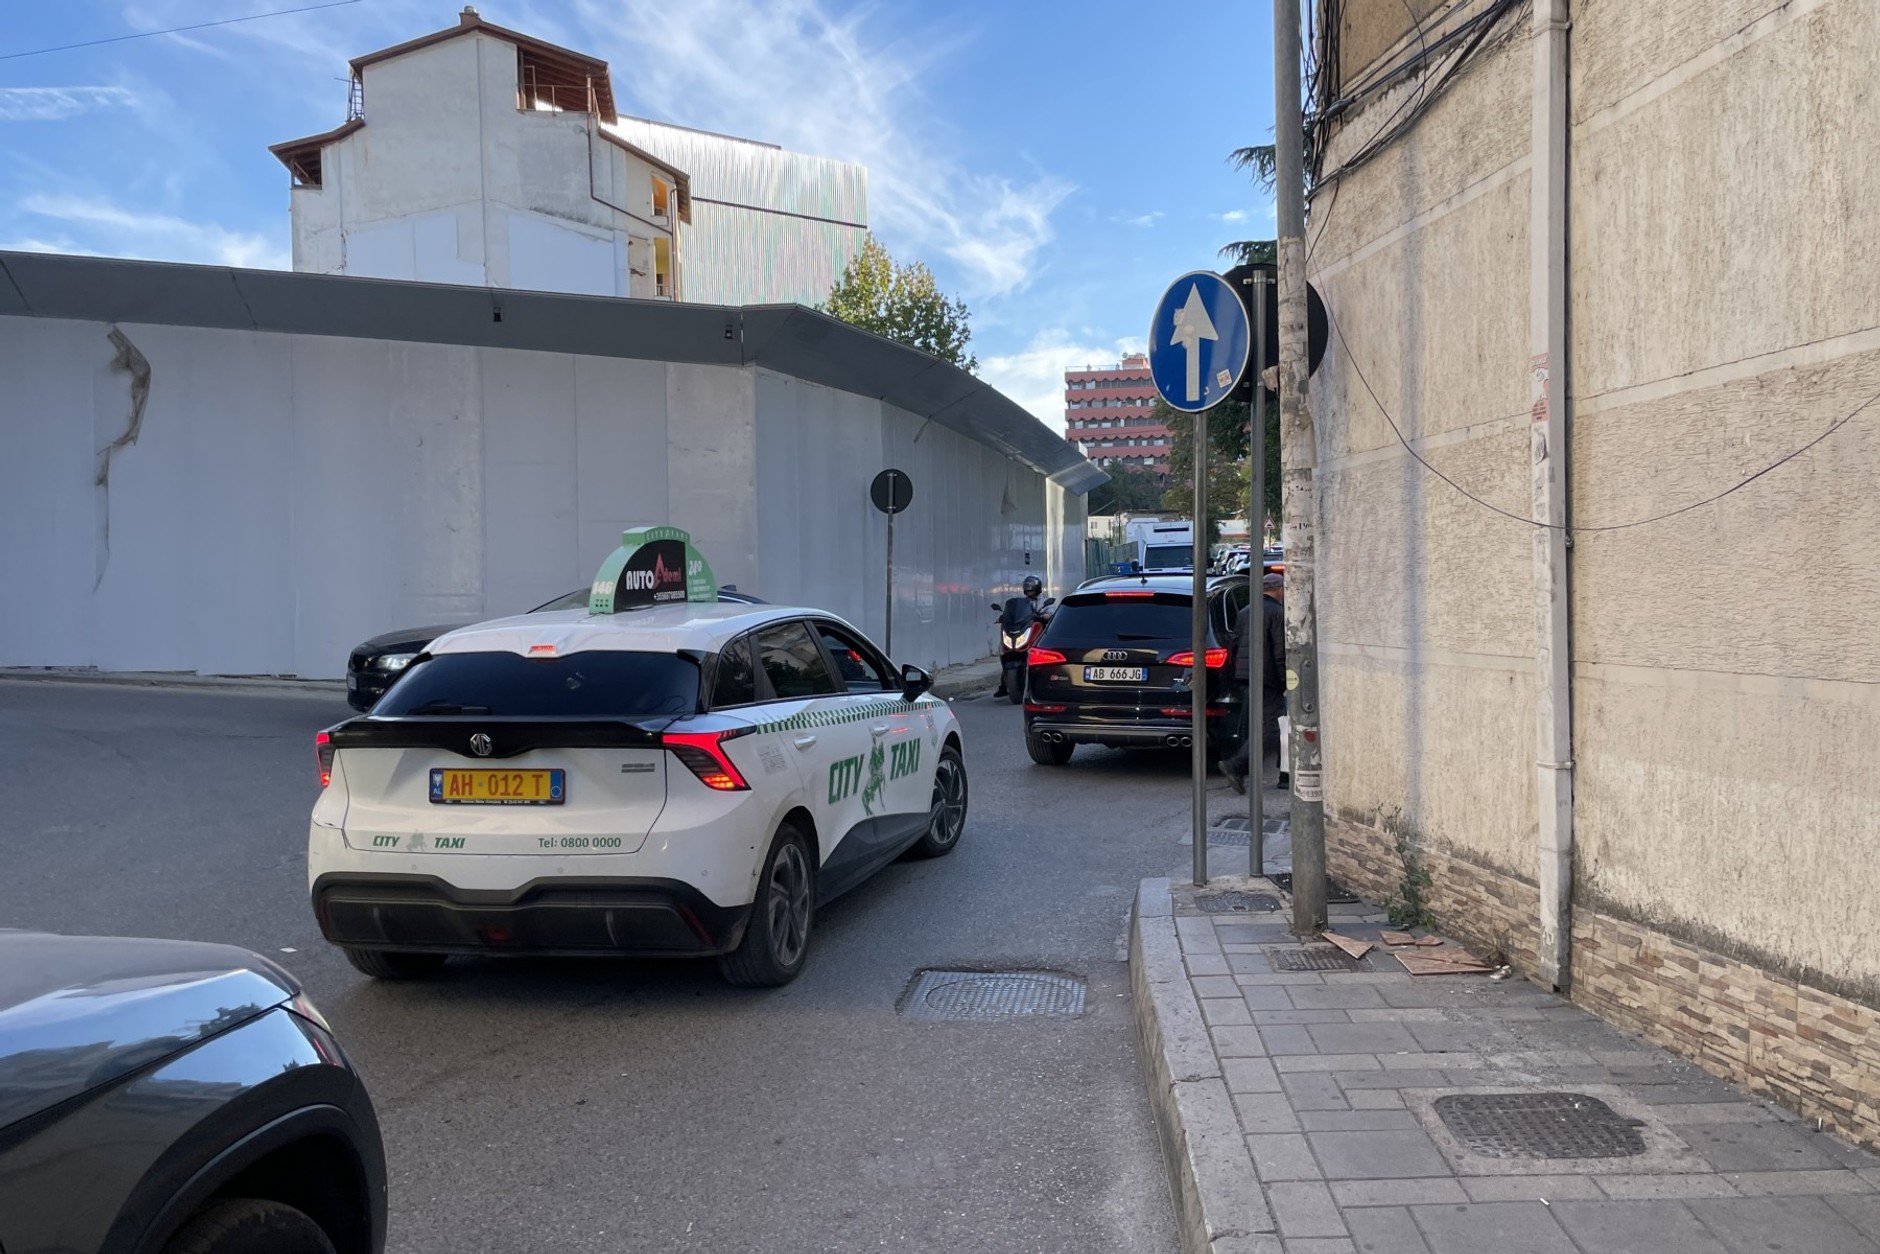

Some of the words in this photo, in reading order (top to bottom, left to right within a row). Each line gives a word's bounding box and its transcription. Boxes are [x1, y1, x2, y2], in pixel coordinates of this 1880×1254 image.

[626, 569, 655, 590] AUTO
[1093, 668, 1105, 680] AB
[1110, 668, 1128, 680] 666
[1129, 668, 1141, 680] JG
[470, 733, 493, 756] MG
[828, 753, 865, 805] CITY
[890, 737, 921, 782] TAXI
[433, 787, 442, 795] AL
[449, 774, 473, 797] AH
[487, 774, 524, 797] 012
[532, 774, 544, 797] T
[372, 835, 400, 848] CITY
[434, 836, 466, 849] TAXI
[538, 837, 558, 848] Tel:
[560, 837, 589, 848] 0800
[592, 837, 622, 848] 0000
